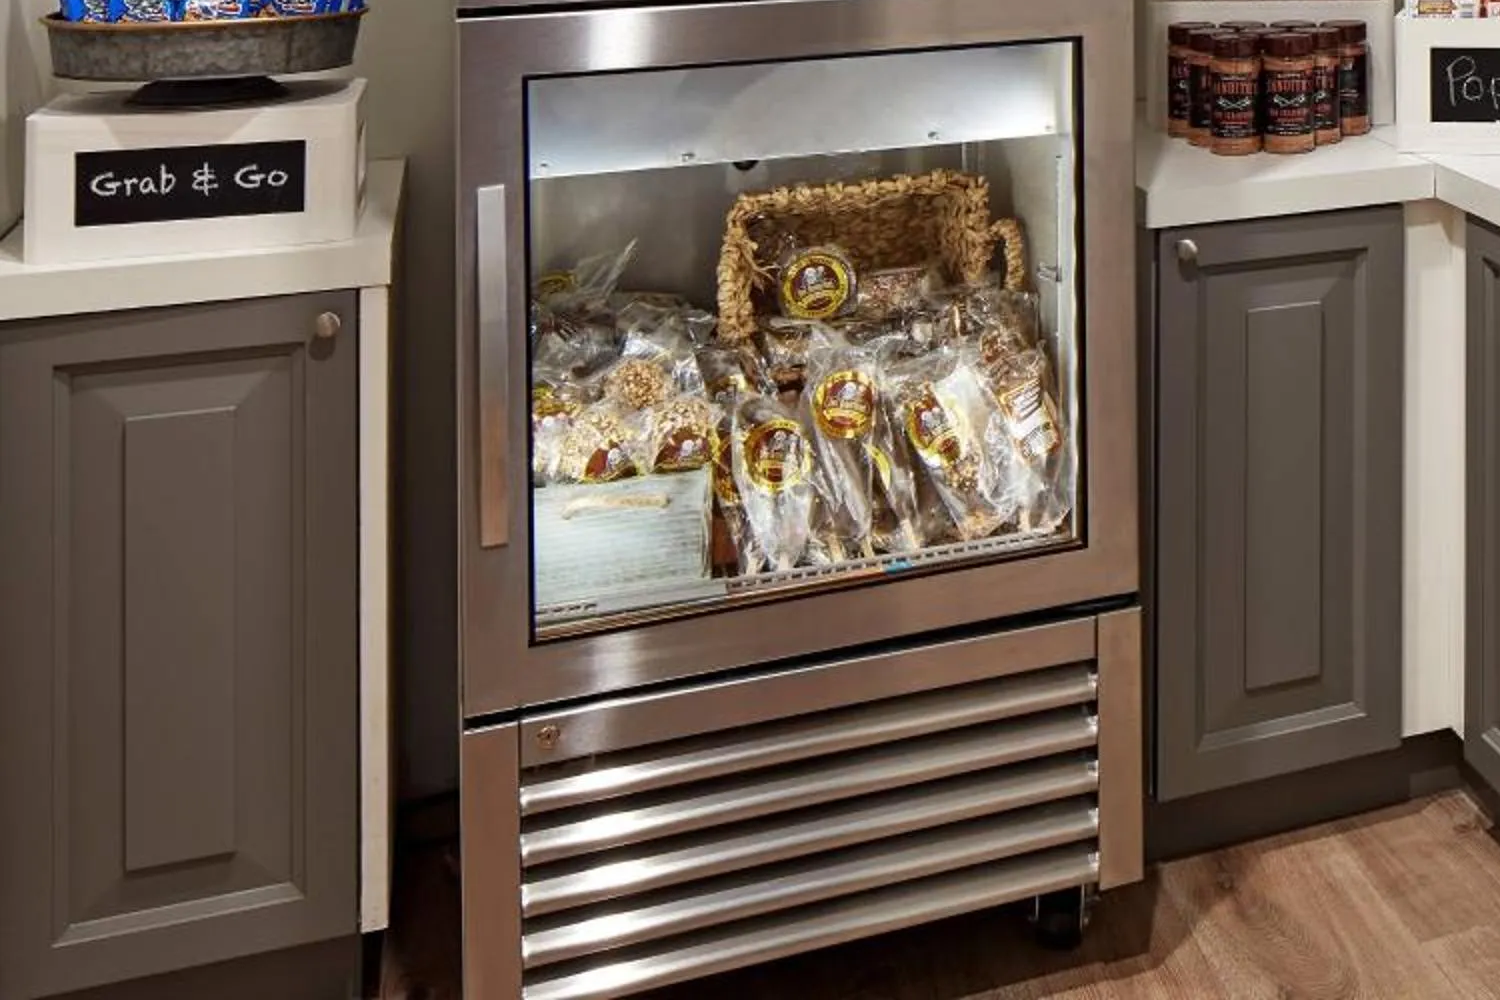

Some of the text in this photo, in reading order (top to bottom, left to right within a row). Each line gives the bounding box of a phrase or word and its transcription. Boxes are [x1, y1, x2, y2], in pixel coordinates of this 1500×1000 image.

[90, 161, 289, 197] Grab & Go
